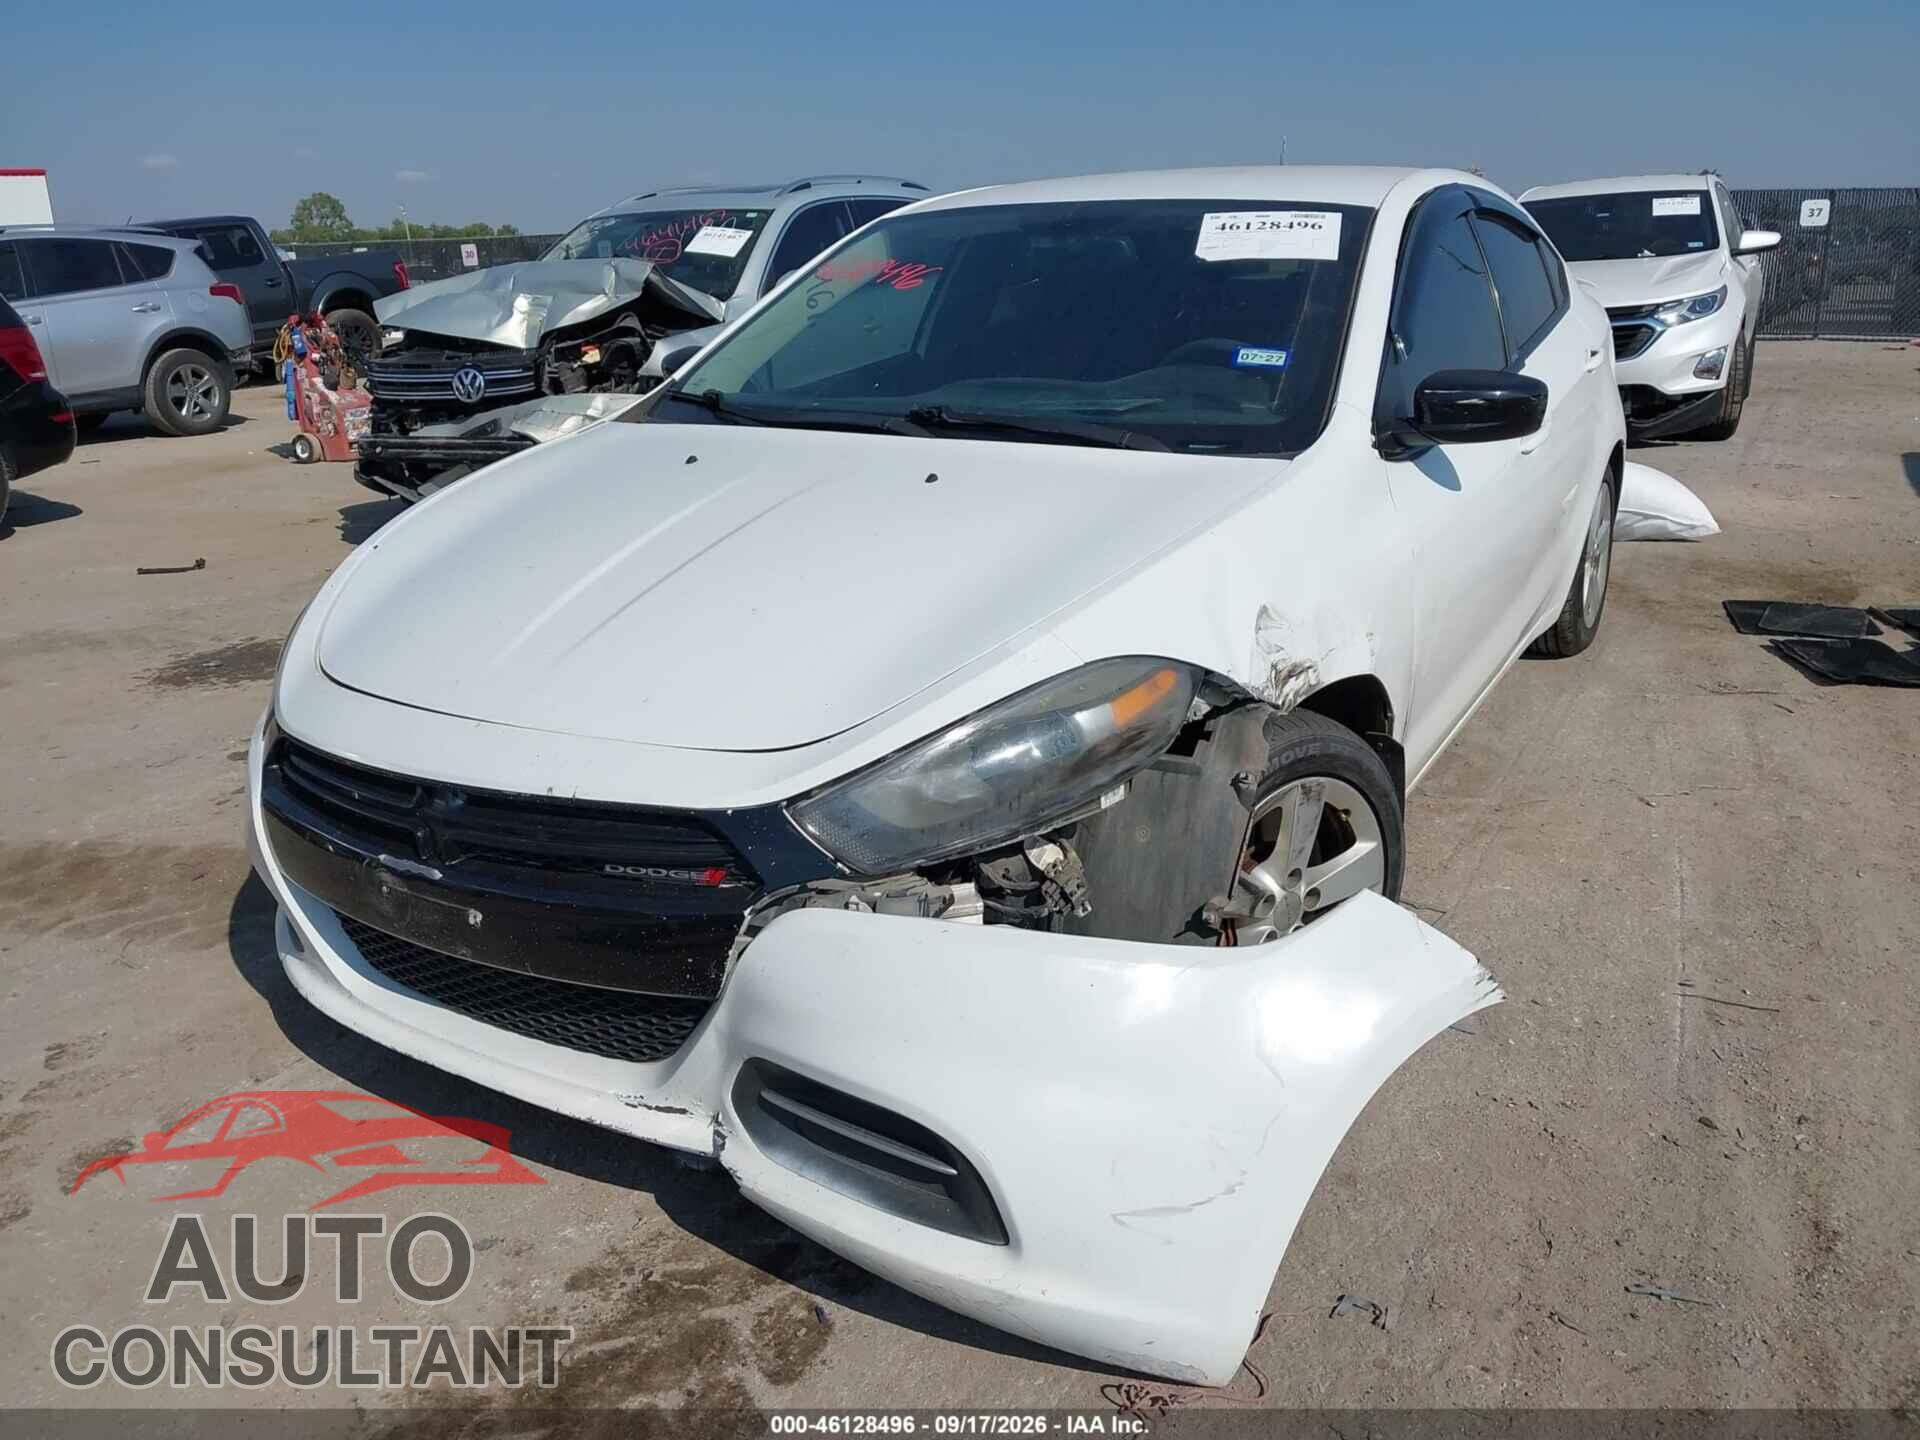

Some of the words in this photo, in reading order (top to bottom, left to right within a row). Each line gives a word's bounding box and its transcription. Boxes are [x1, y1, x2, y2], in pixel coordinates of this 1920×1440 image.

[1807, 207, 1824, 218] 37
[1214, 221, 1324, 232] 46128496
[1240, 352, 1284, 363] 07-27
[604, 864, 709, 885] DODGE
